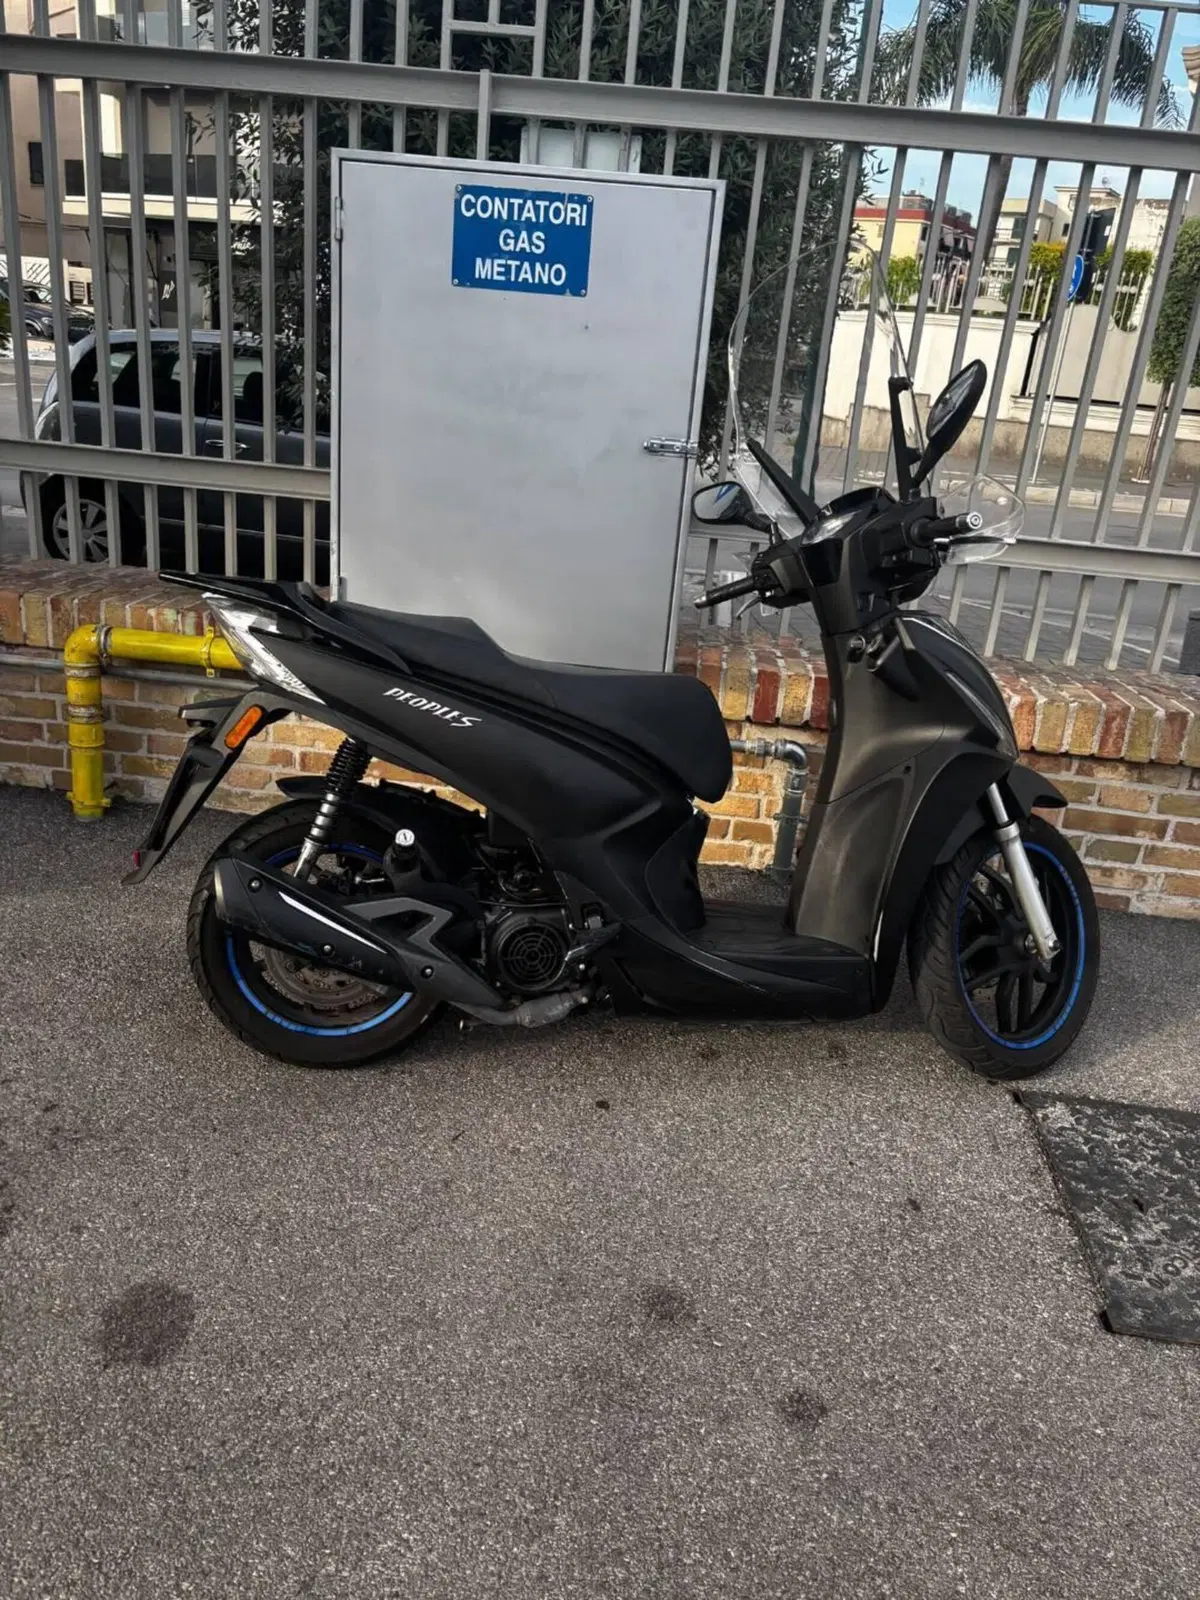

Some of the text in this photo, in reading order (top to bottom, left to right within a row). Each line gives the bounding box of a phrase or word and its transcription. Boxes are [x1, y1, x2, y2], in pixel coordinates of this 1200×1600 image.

[461, 194, 587, 226] CONTATORI
[499, 228, 546, 254] GAS
[475, 257, 566, 286] METANO
